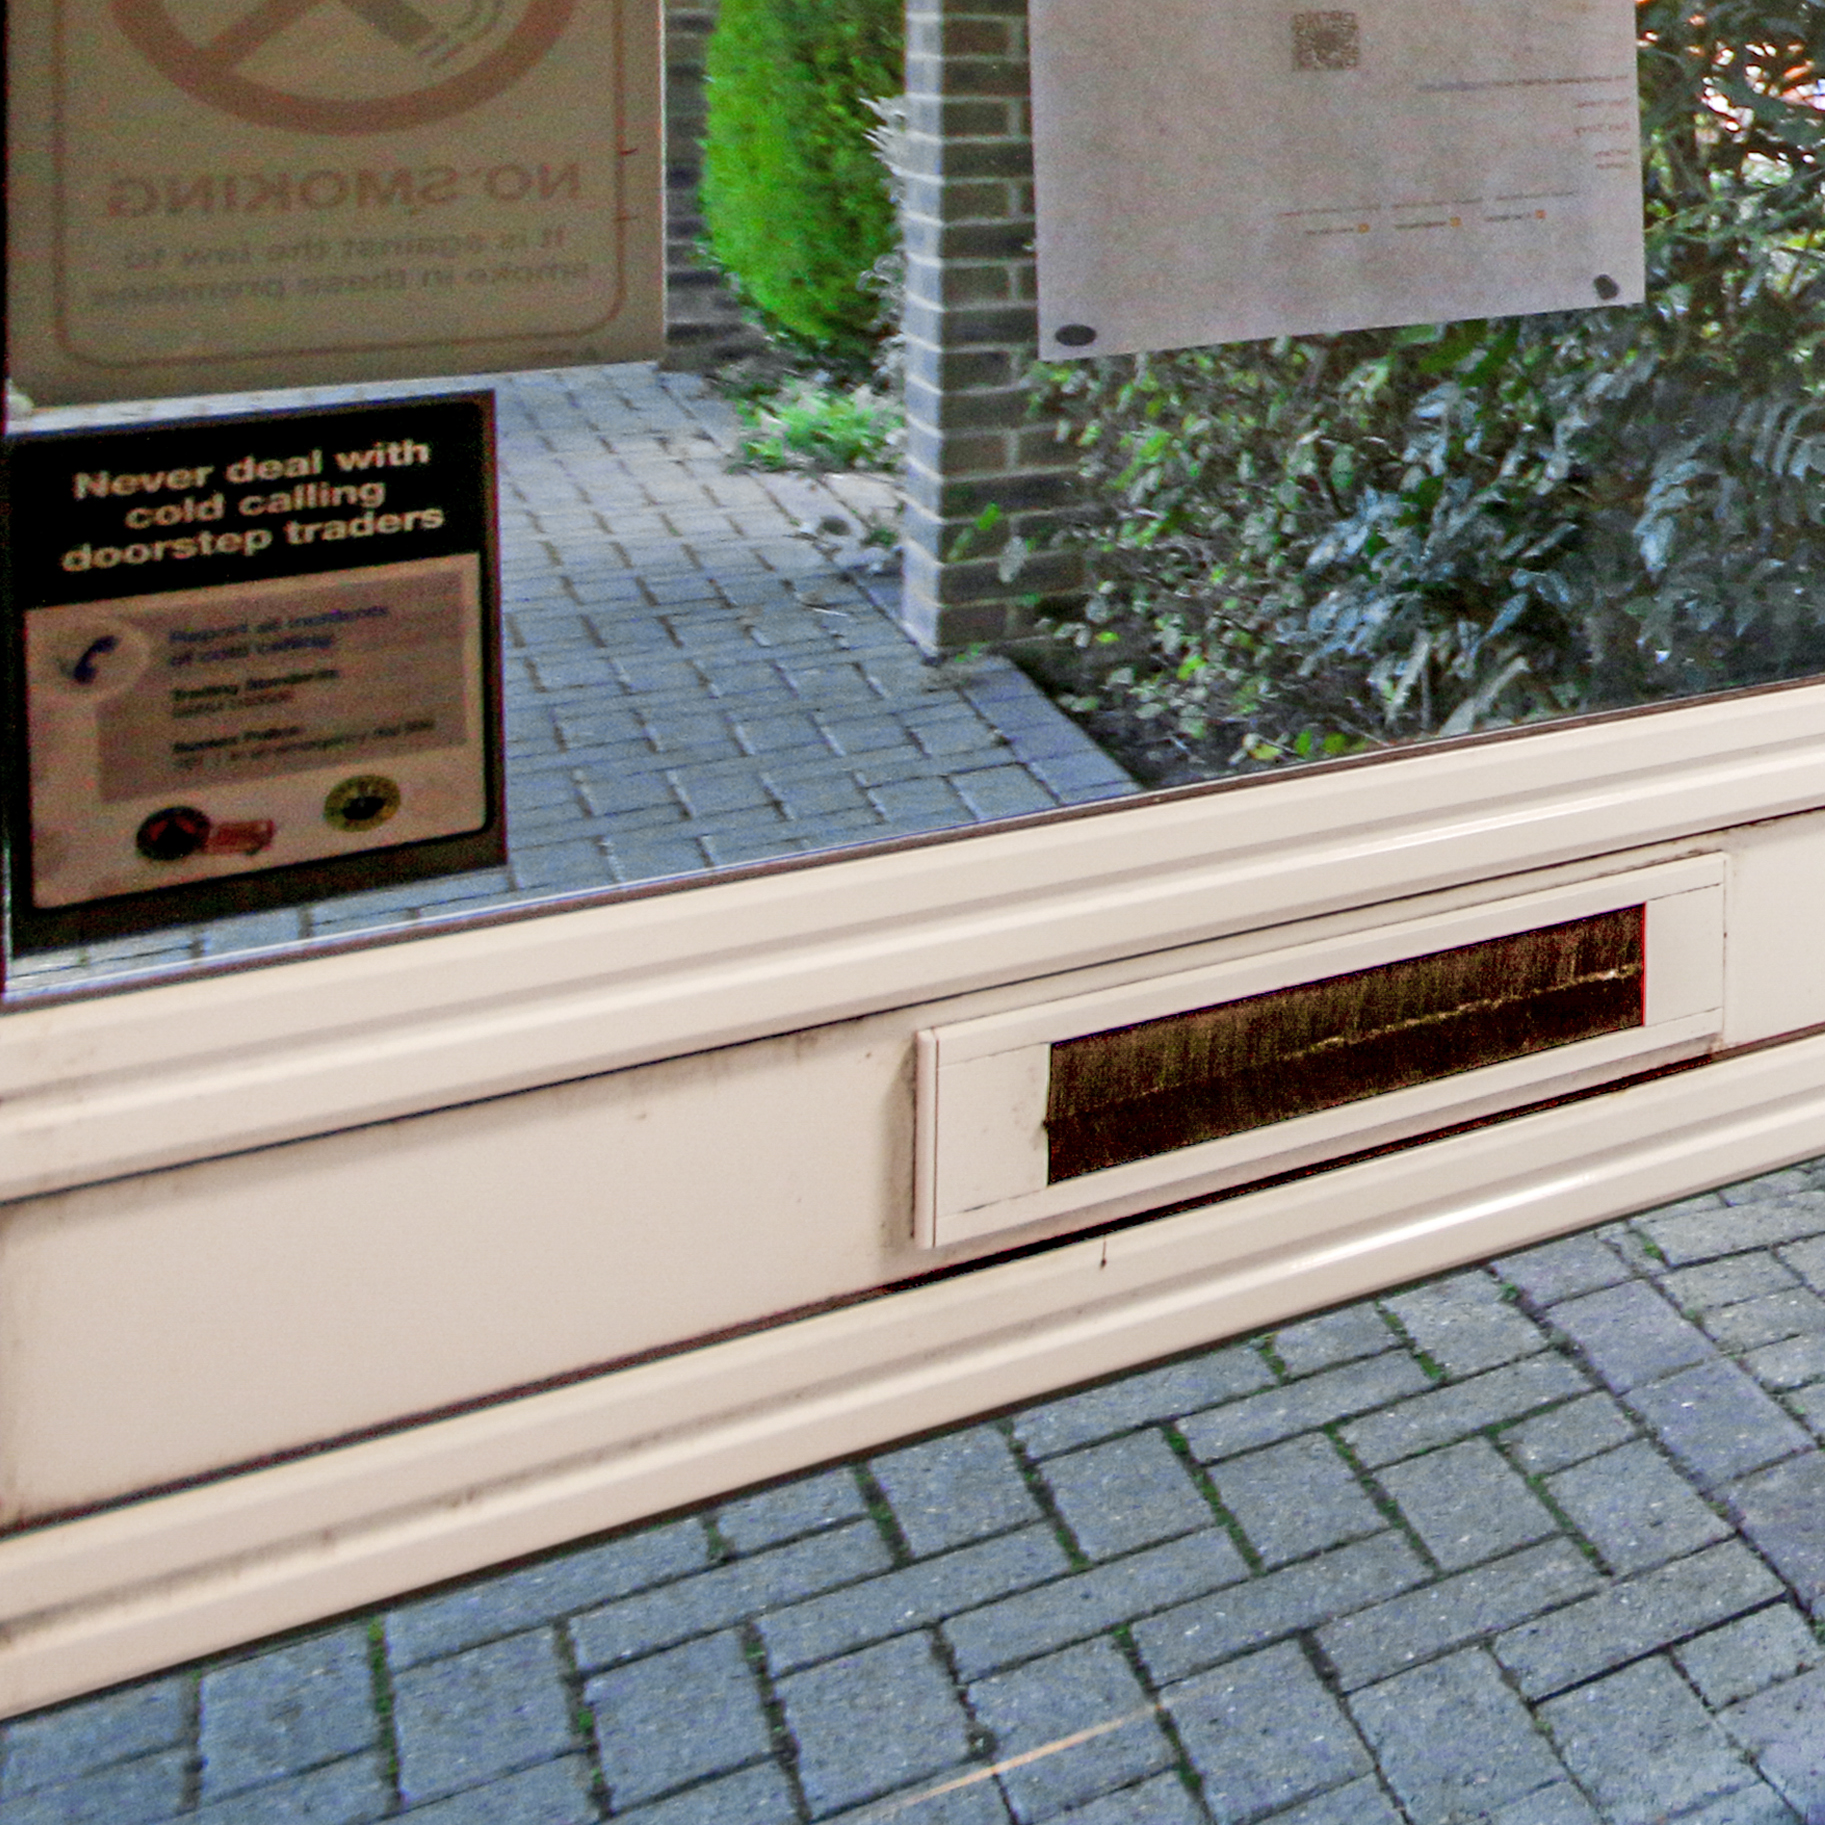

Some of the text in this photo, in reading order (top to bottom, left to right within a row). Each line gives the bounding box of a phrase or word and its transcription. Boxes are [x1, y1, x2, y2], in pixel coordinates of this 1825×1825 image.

[72, 438, 431, 500] Never deal with
[125, 481, 386, 530] cold calling
[61, 508, 445, 572] doorstep traders
